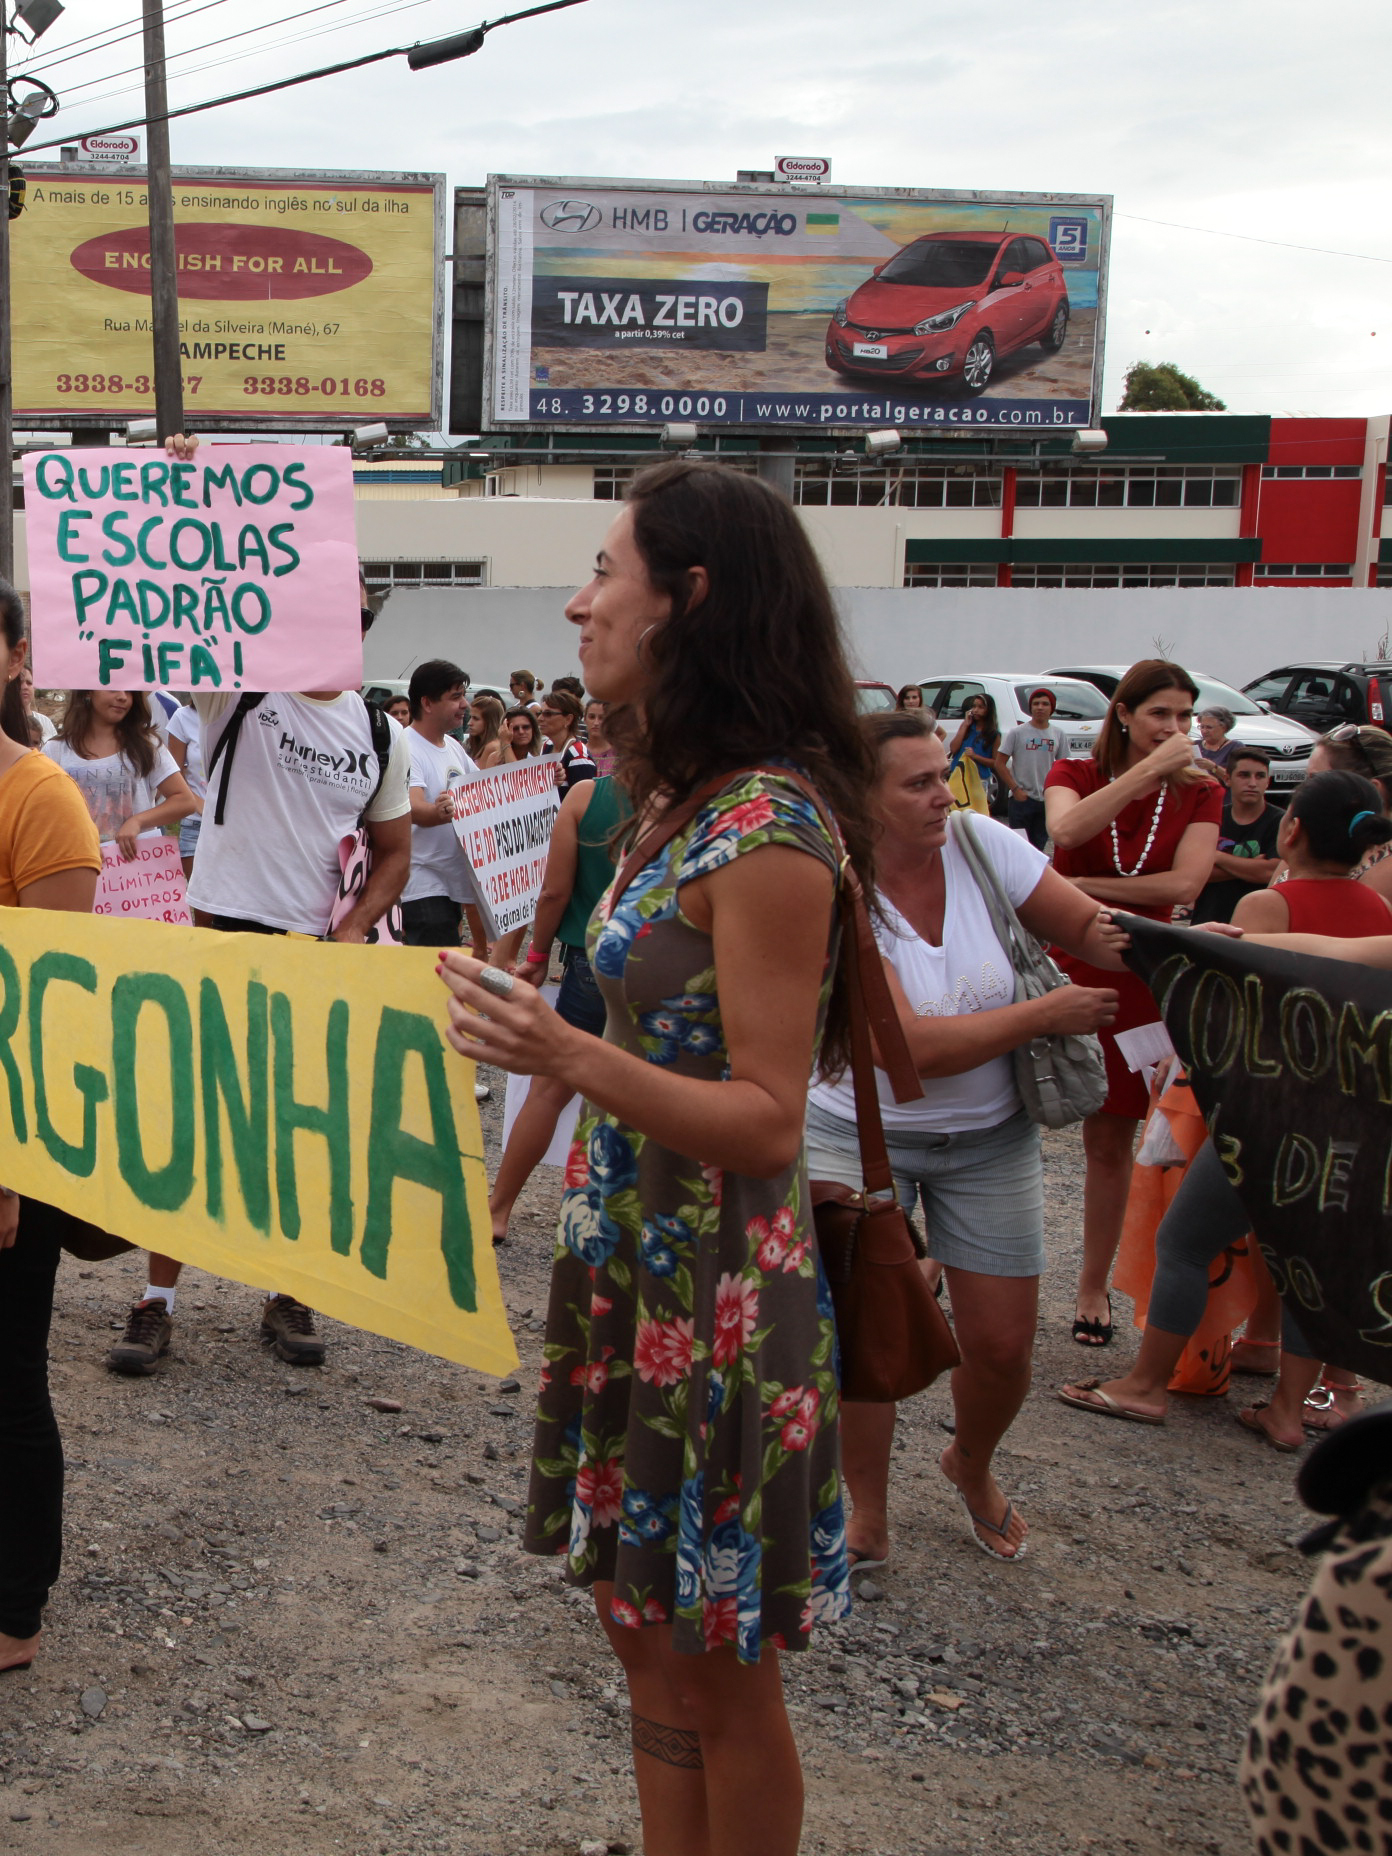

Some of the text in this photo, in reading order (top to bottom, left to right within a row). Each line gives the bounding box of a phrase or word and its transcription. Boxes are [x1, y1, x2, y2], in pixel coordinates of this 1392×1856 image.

[90, 139, 130, 149] Eldorado
[786, 161, 821, 171] Eldorado
[786, 174, 821, 182] 3244-4704
[33, 188, 45, 202] A
[49, 189, 86, 205] mais
[90, 190, 110, 205] de
[116, 191, 134, 205] 15
[139, 191, 176, 207] as
[181, 193, 260, 210] ensinando
[264, 196, 308, 214] inglês
[336, 198, 357, 212] sul
[362, 198, 379, 212] da
[384, 199, 409, 214] ilha
[612, 207, 797, 239] HMB GERAÇÃO
[1058, 227, 1079, 246] 5
[104, 251, 343, 275] ENGISH FOR ALL
[558, 291, 744, 328] TAXA ZERO
[104, 318, 340, 337] Rua Mael da Silveira (Mané), 67
[621, 329, 644, 339] partir
[645, 330, 671, 339] 0,39%
[672, 331, 685, 339] cet
[179, 342, 286, 361] AMPECHE
[56, 374, 387, 397] 3338-37 3338-0168
[536, 397, 570, 414] 48.
[582, 395, 727, 417] 3298.0000
[757, 400, 1075, 424] www.portalgeracao.com.br
[35, 453, 315, 512] QUEREMOS
[56, 509, 301, 578] ESCOLAS
[71, 568, 273, 636] PADRÃO
[279, 732, 345, 771] Hurley
[302, 764, 372, 790] estudantil
[309, 776, 328, 788] praia
[328, 780, 346, 791] mole
[493, 773, 503, 807] O
[469, 829, 485, 869] LEI
[483, 826, 497, 864] DO
[494, 820, 514, 860] PISO
[511, 818, 525, 854] DO
[498, 869, 510, 903] DE
[509, 864, 531, 898] HORA
[121, 889, 182, 912] OUTROS
[494, 904, 523, 932] Regional
[521, 903, 530, 920] de
[1273, 1132, 1359, 1214] DE
